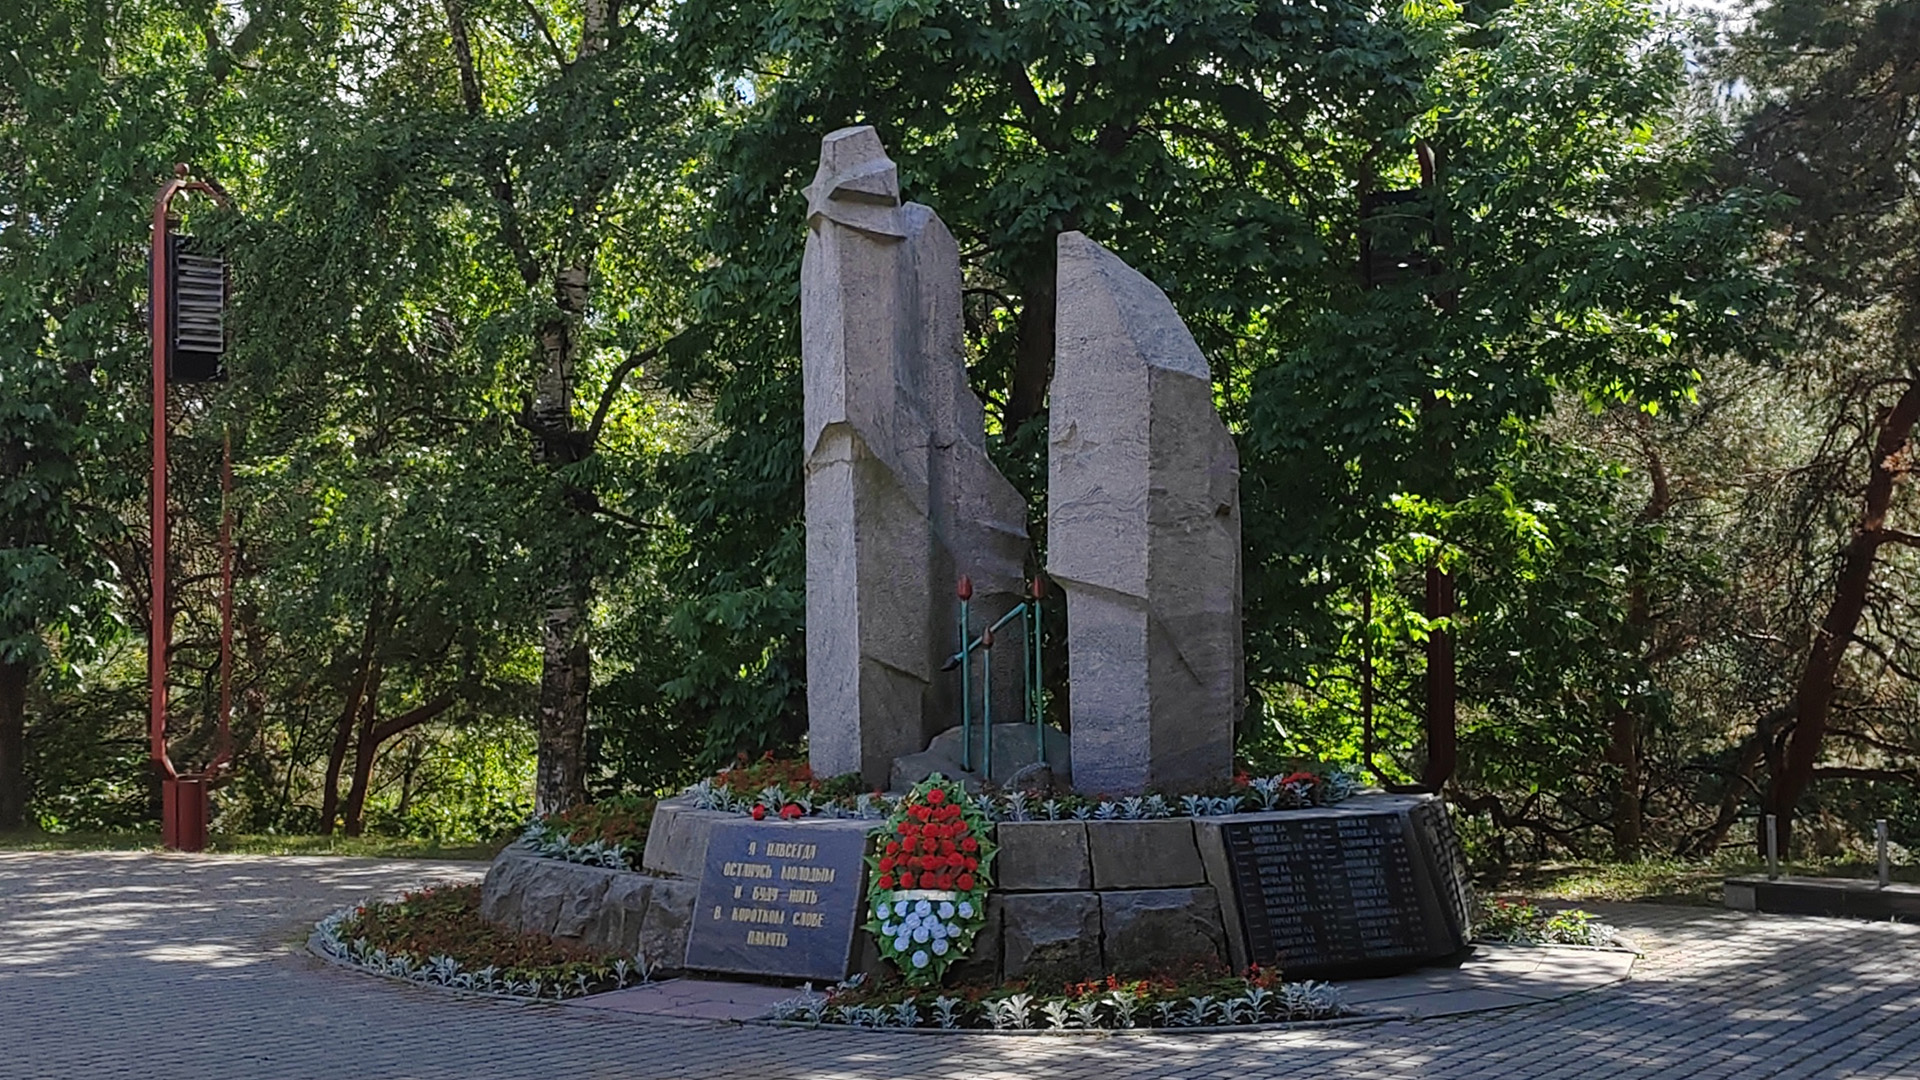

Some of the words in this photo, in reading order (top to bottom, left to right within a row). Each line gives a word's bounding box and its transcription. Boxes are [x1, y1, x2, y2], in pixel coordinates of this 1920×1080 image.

[749, 842, 757, 855] Я
[766, 843, 817, 859] НАВСЕГДА
[723, 862, 772, 877] ОСТАНУСЬ
[781, 865, 835, 882] МОЛОДЫМ
[734, 886, 742, 899] И
[752, 887, 779, 902] БУДУ
[788, 889, 818, 903] ЖИТЬ
[714, 906, 721, 920] В
[732, 907, 785, 924] КОРОТКОМ
[792, 912, 824, 928] СЛОВЕ
[747, 931, 788, 947] ПАМЯТЬ
